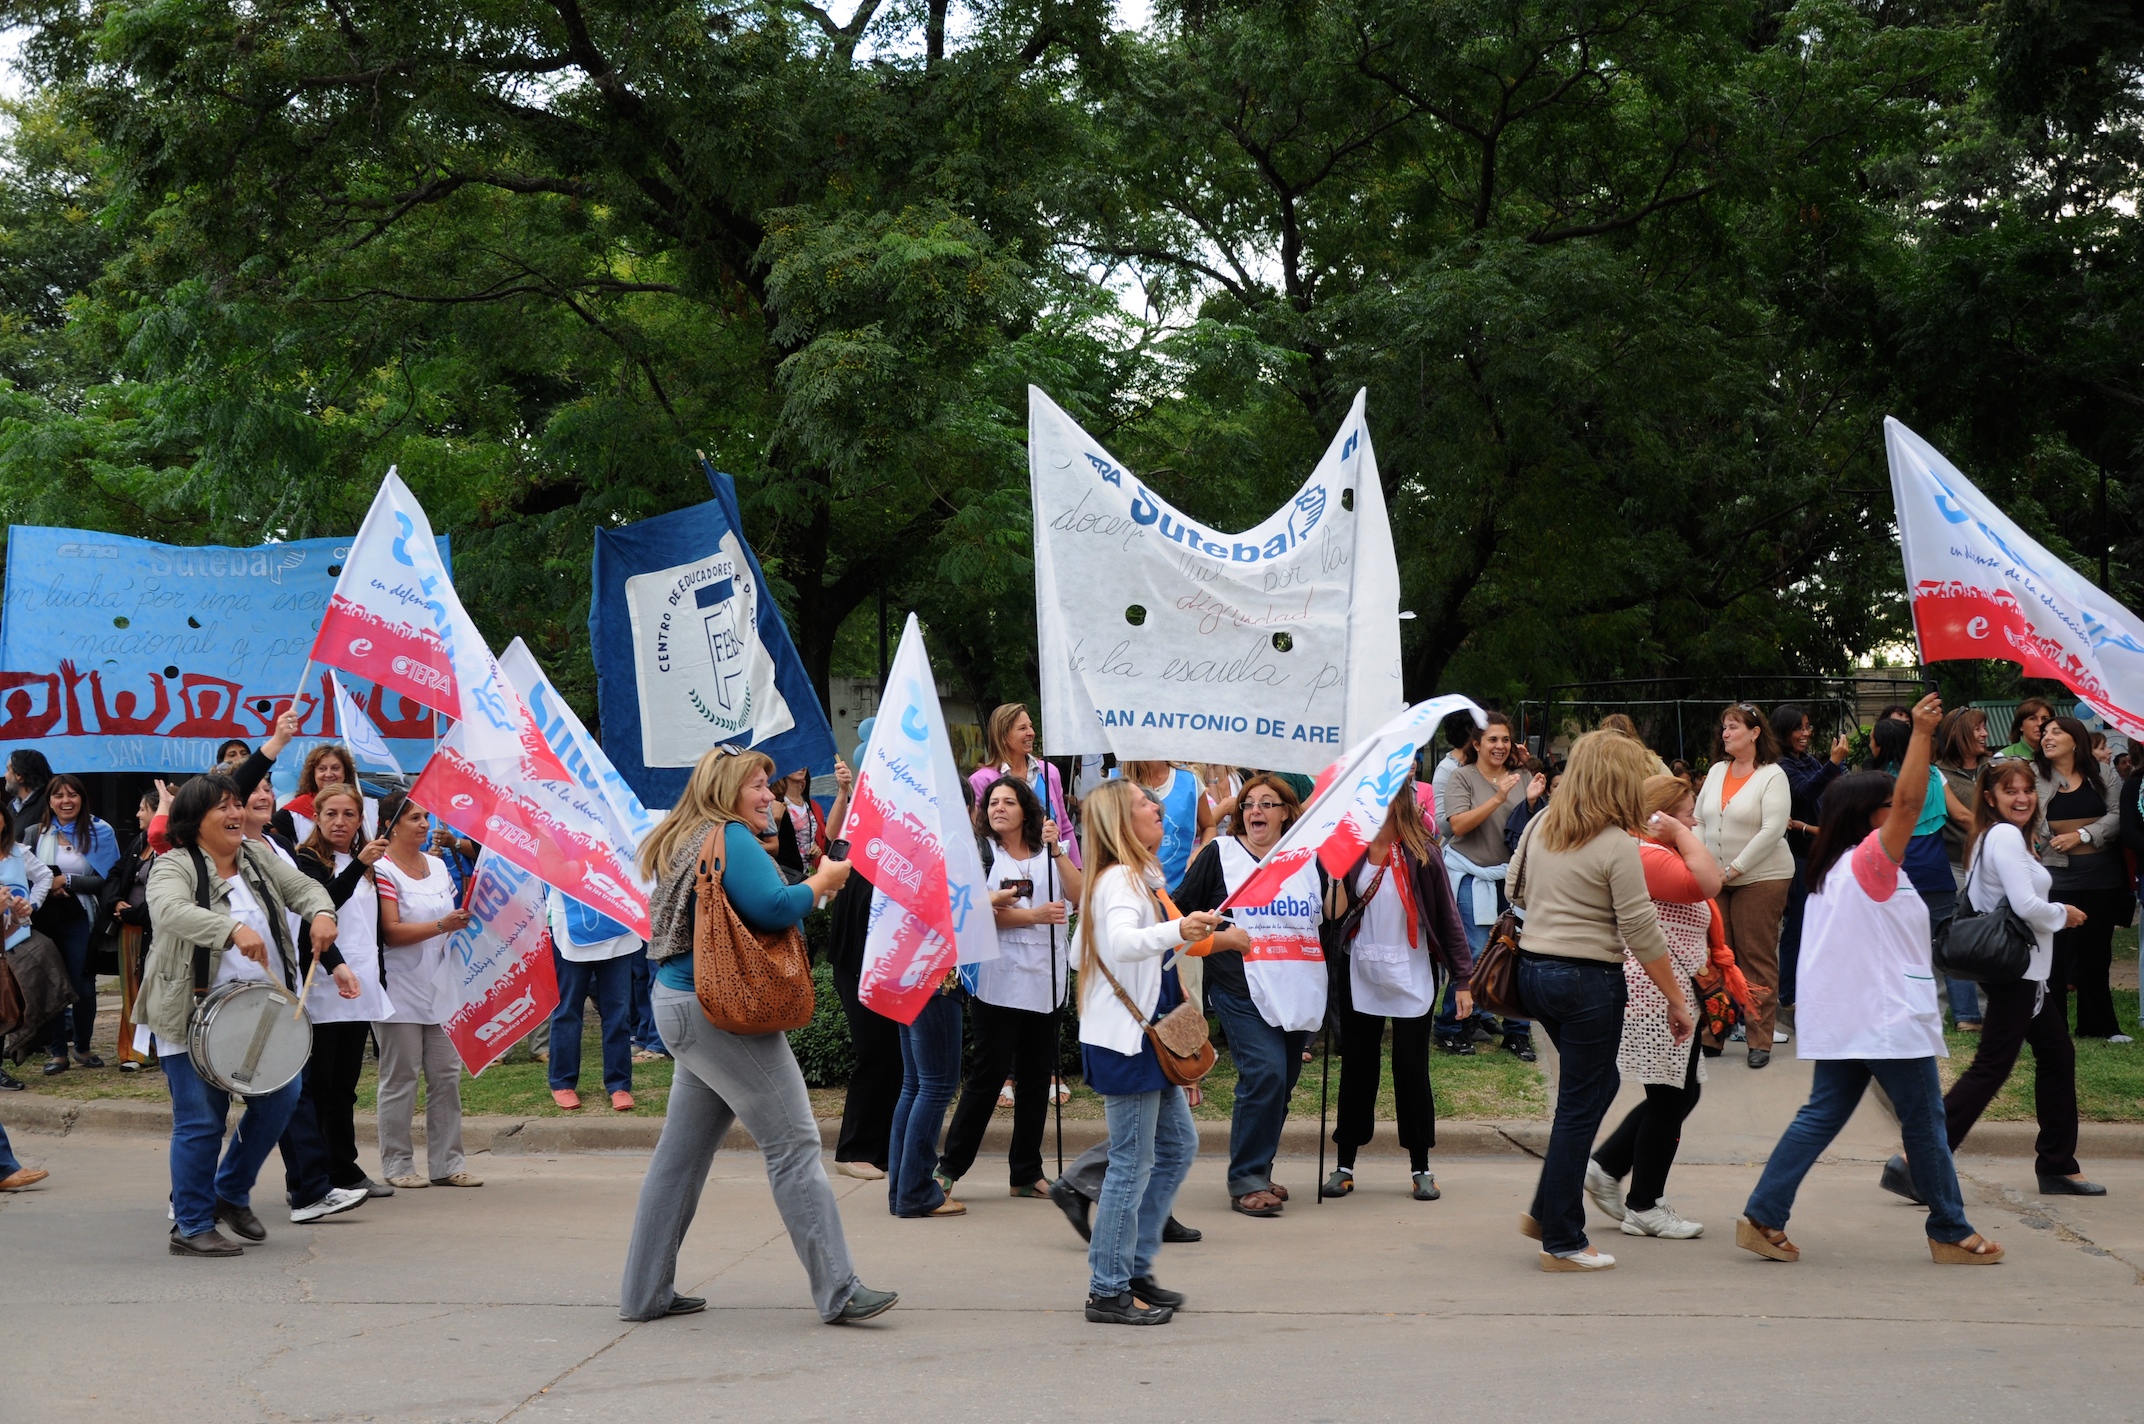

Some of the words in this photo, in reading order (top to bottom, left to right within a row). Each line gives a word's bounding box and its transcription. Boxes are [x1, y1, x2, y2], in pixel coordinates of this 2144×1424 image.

[1130, 485, 1287, 563] Suteba
[57, 543, 119, 559] CTA
[151, 547, 269, 578] Suteba
[1264, 565, 1309, 593] por
[1322, 525, 1348, 575] la
[132, 590, 188, 619] por
[658, 612, 672, 672] CENTRO
[668, 589, 682, 606] DE
[677, 561, 733, 594] EDUCADORES
[2005, 567, 2020, 581] de
[2024, 578, 2037, 595] la
[2040, 594, 2091, 648] educación
[71, 620, 219, 665] nacional
[1097, 640, 1143, 677] la
[1159, 635, 1290, 686] escuela
[391, 655, 451, 697] CTERA
[1141, 711, 1248, 733] ANTONIO
[1256, 717, 1286, 739] DE
[107, 738, 146, 768] SAN
[542, 780, 557, 793] de
[558, 787, 571, 802] la
[886, 757, 929, 797] defensa
[485, 815, 541, 857] CTERA
[865, 837, 924, 894] CTERA
